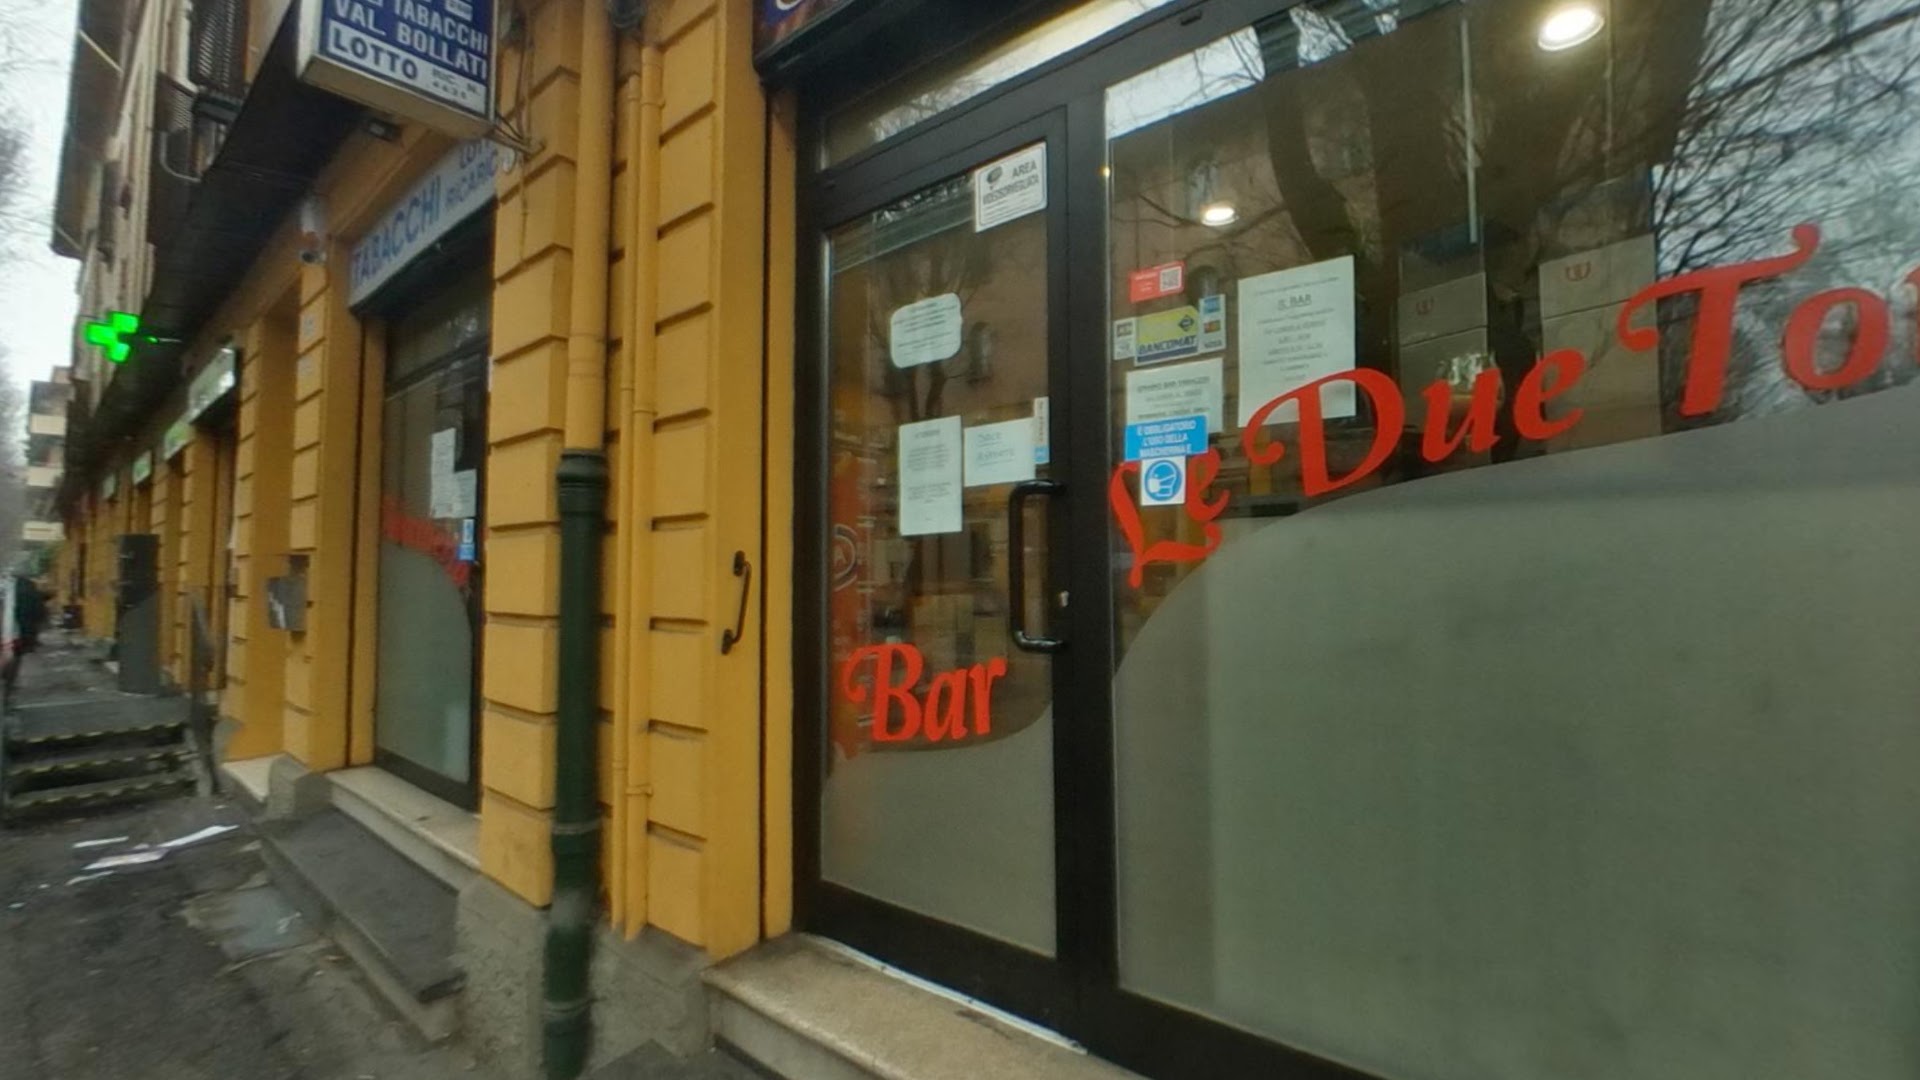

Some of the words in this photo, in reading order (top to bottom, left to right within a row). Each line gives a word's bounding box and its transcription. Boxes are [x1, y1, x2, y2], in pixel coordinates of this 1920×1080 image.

[332, 27, 419, 81] LOTTO
[397, 22, 488, 80] BOLLATI
[1012, 160, 1037, 178] AREA
[351, 174, 441, 288] TABACCHI
[1137, 335, 1197, 355] BANCOMAT
[1108, 446, 1231, 588] Le
[1242, 347, 1585, 497] Due
[842, 642, 1007, 742] Bar
